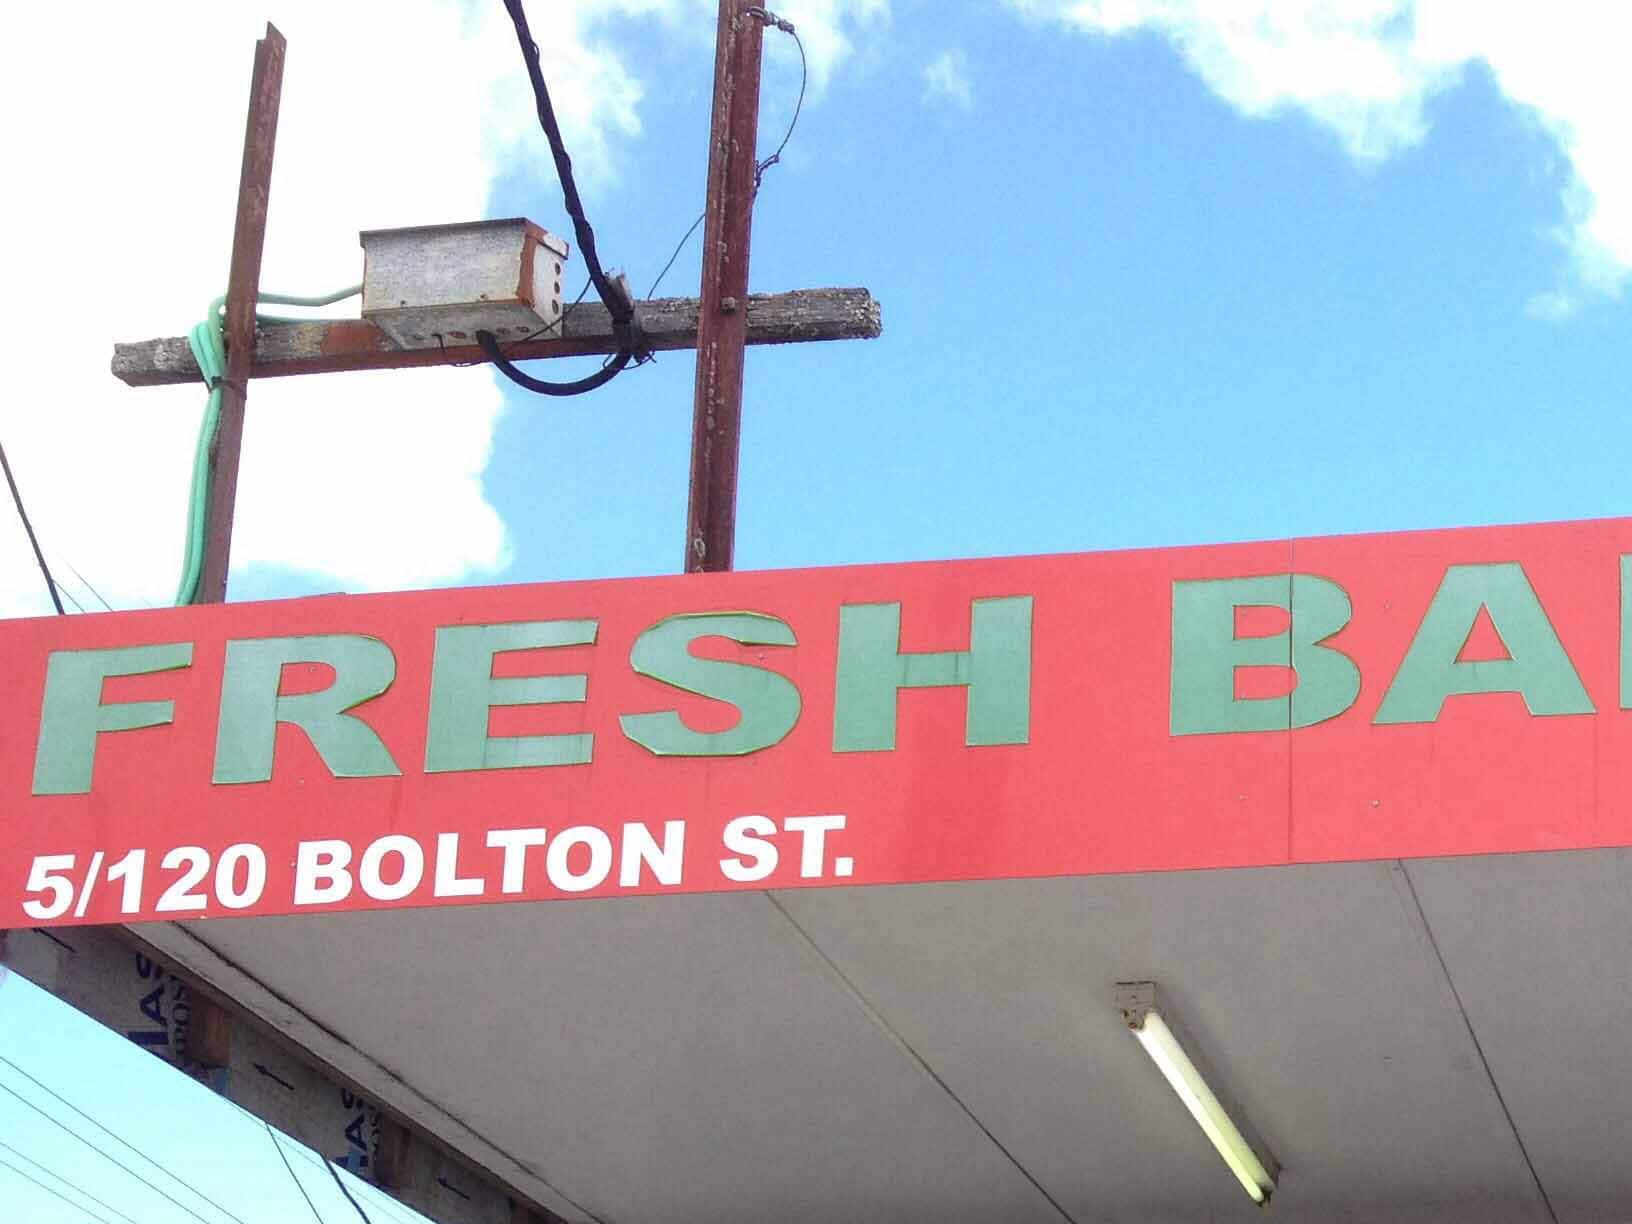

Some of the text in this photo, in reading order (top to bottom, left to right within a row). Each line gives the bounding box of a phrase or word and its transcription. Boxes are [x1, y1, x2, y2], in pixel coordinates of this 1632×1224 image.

[32, 595, 1034, 795] FRESH
[22, 814, 855, 920] 5/120 BOLTON ST.
